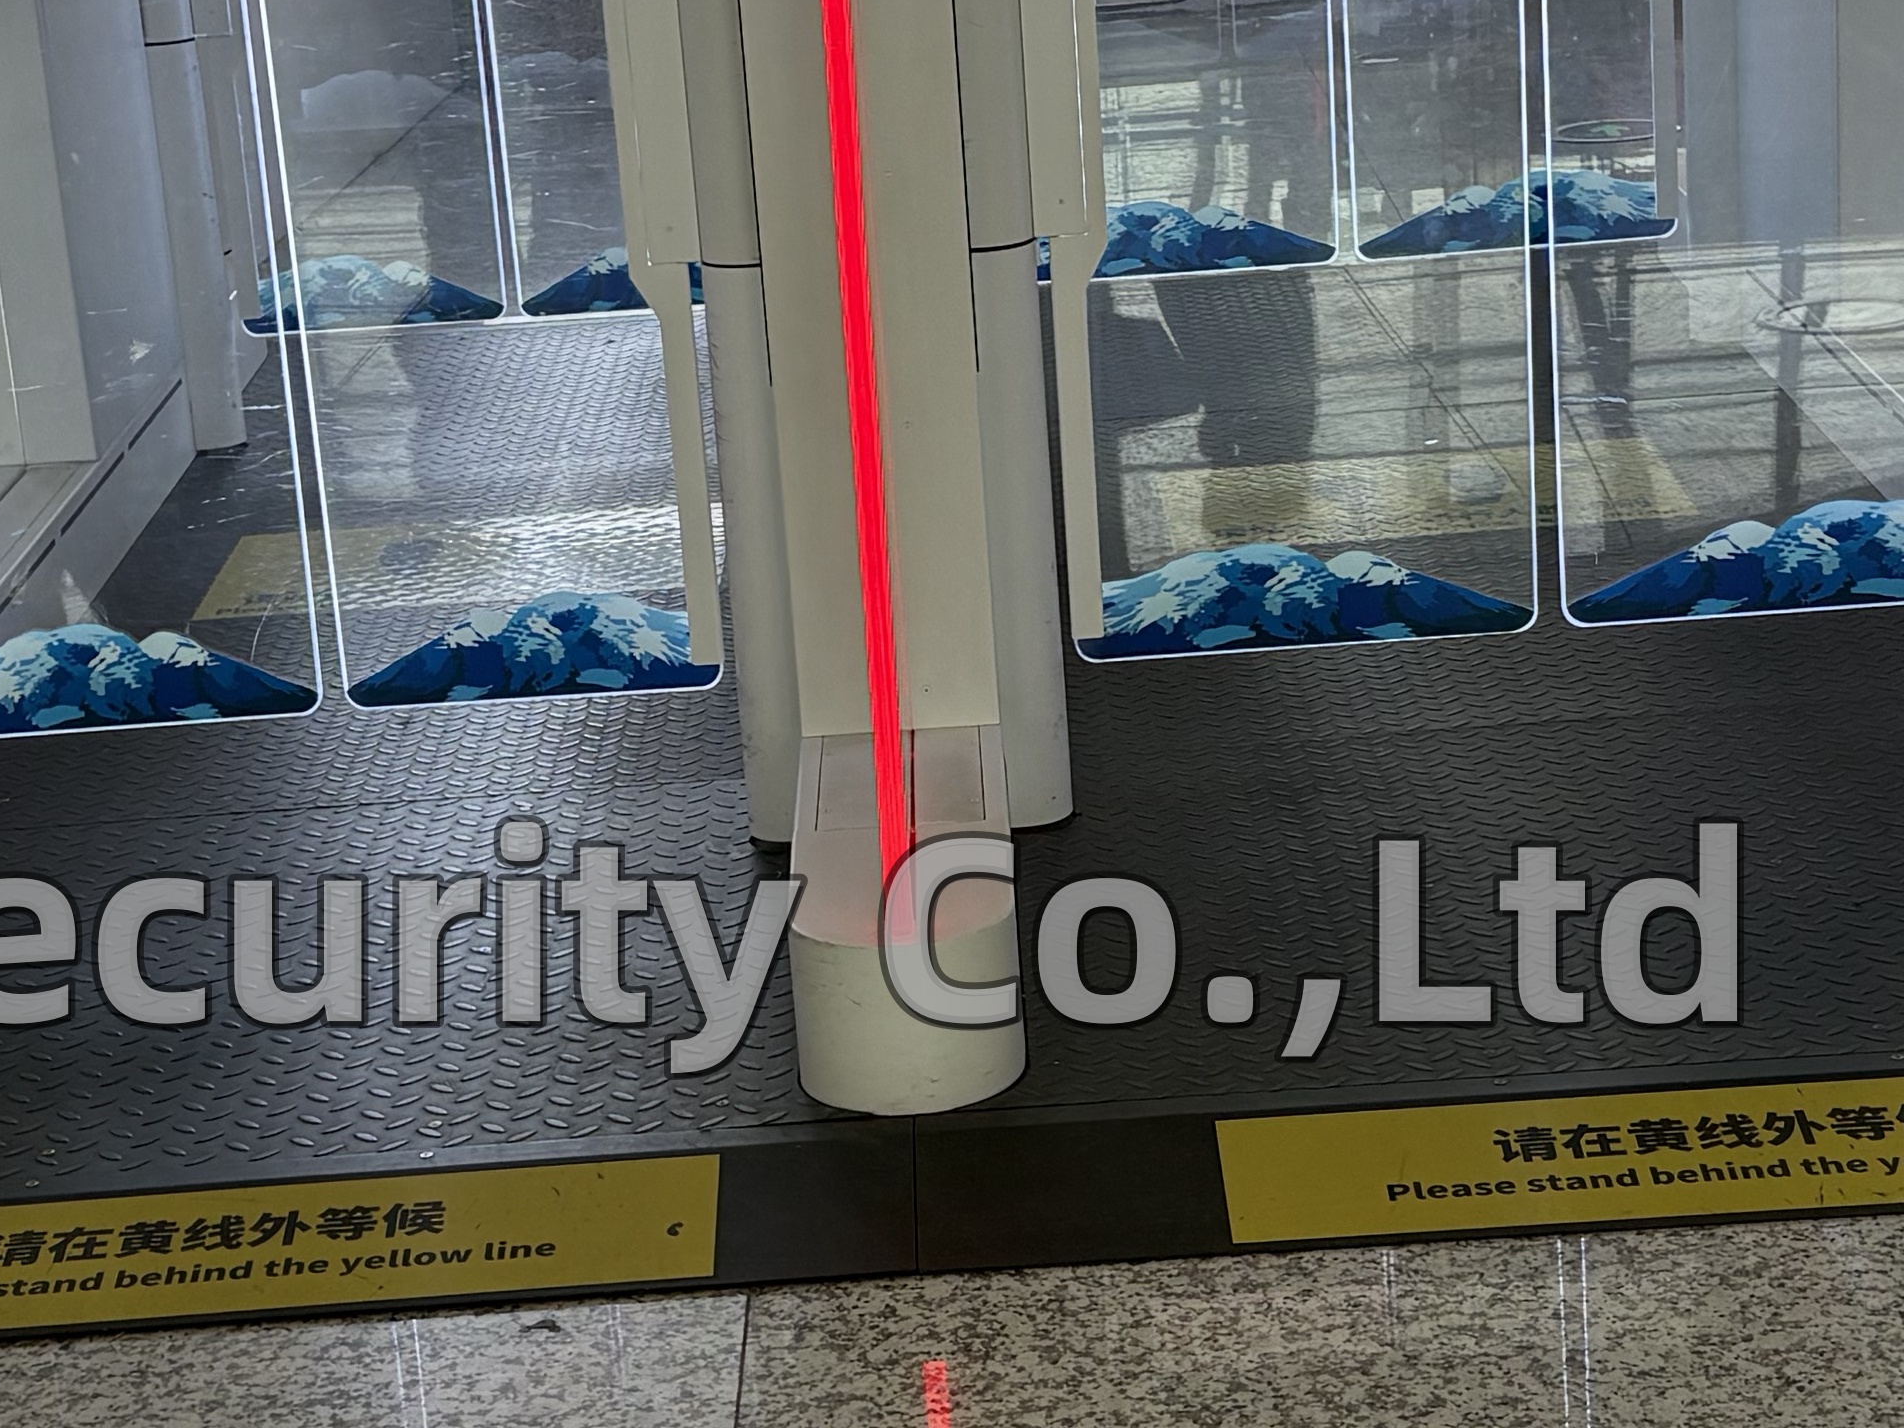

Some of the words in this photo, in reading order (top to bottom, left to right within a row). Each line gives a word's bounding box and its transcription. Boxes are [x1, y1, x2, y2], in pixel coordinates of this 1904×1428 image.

[1385, 1176, 1517, 1204] Please
[1527, 1166, 1641, 1196] stand
[1652, 1157, 1793, 1187] behind
[1800, 1151, 1869, 1180] the
[114, 1260, 254, 1292] behind
[264, 1255, 330, 1281] the
[341, 1245, 474, 1278] yellow
[485, 1237, 559, 1264] line
